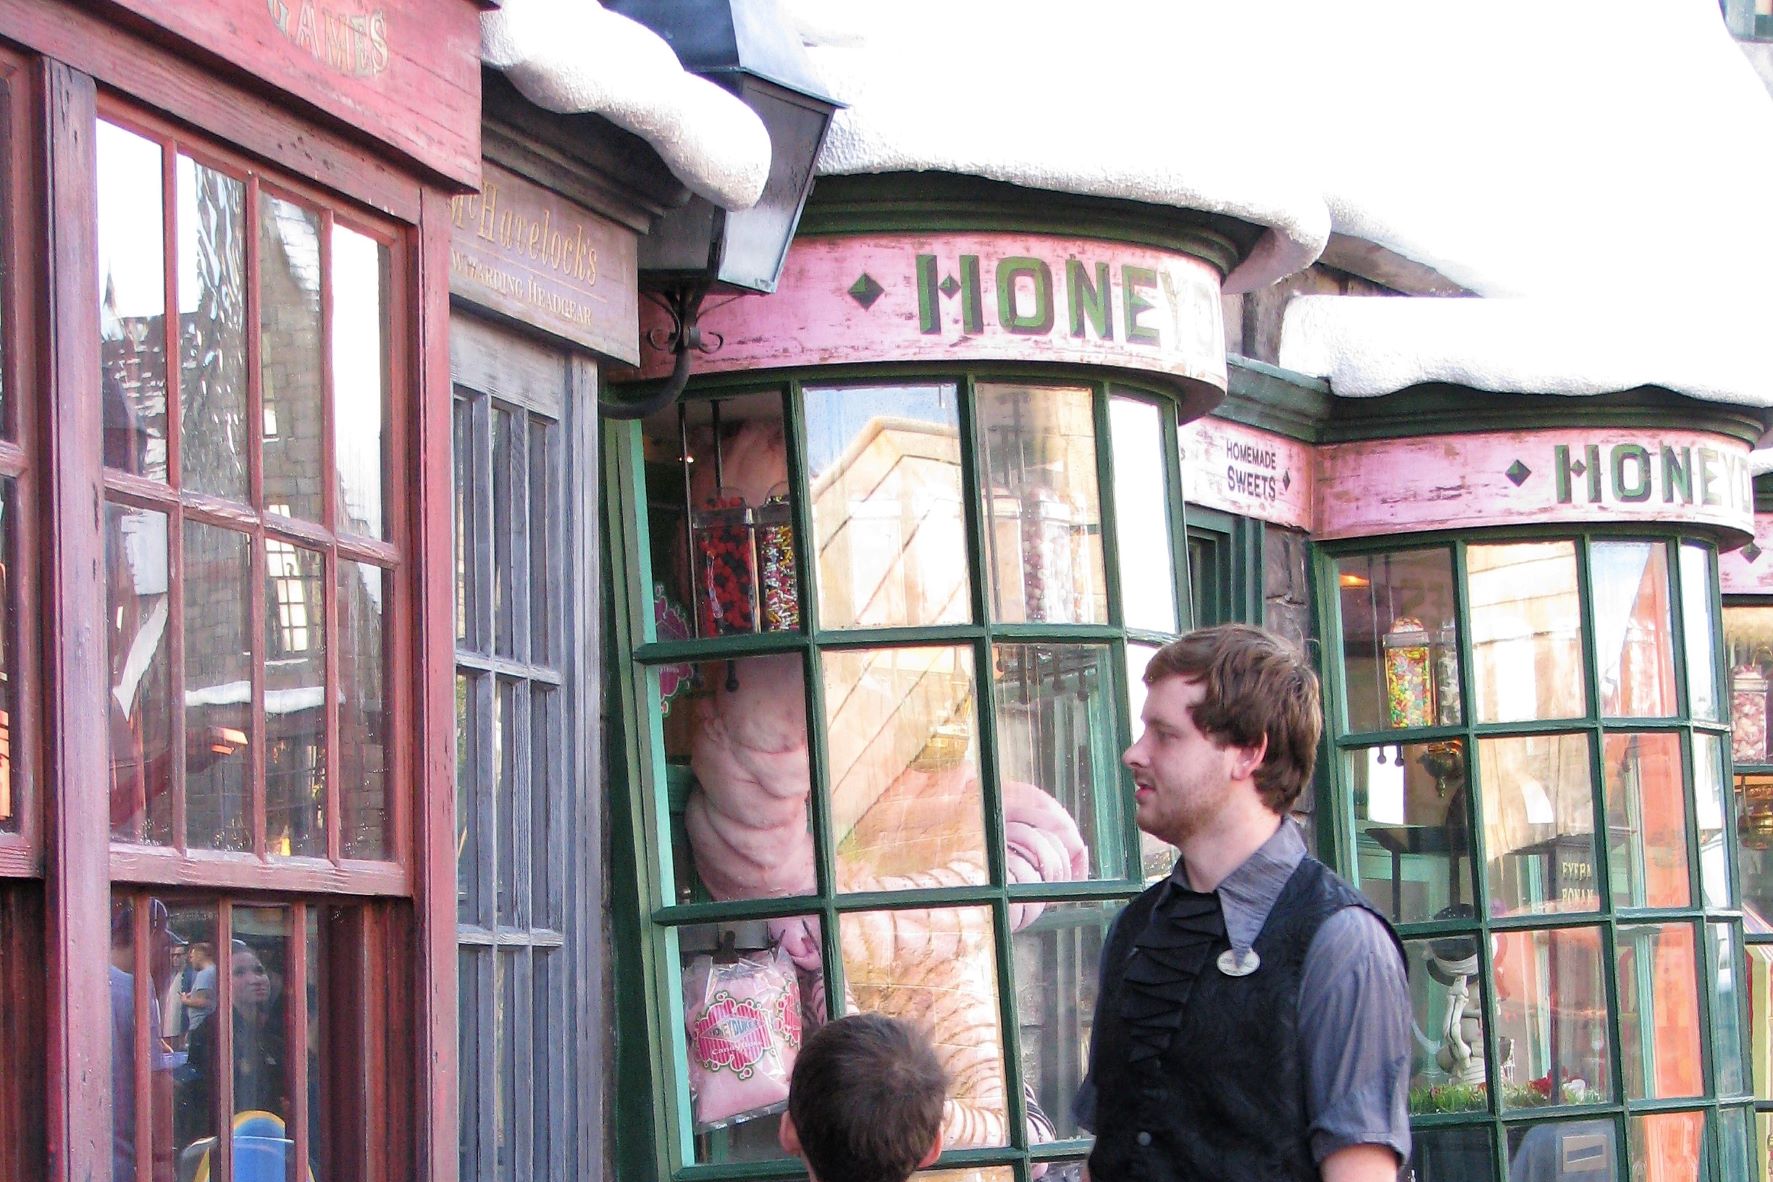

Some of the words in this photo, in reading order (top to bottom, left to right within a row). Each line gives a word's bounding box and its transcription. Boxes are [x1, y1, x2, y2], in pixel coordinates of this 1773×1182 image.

[528, 275, 593, 326] HEADGEAR
[1226, 440, 1277, 470] HOMEMADE
[1227, 465, 1276, 502] SWEETS
